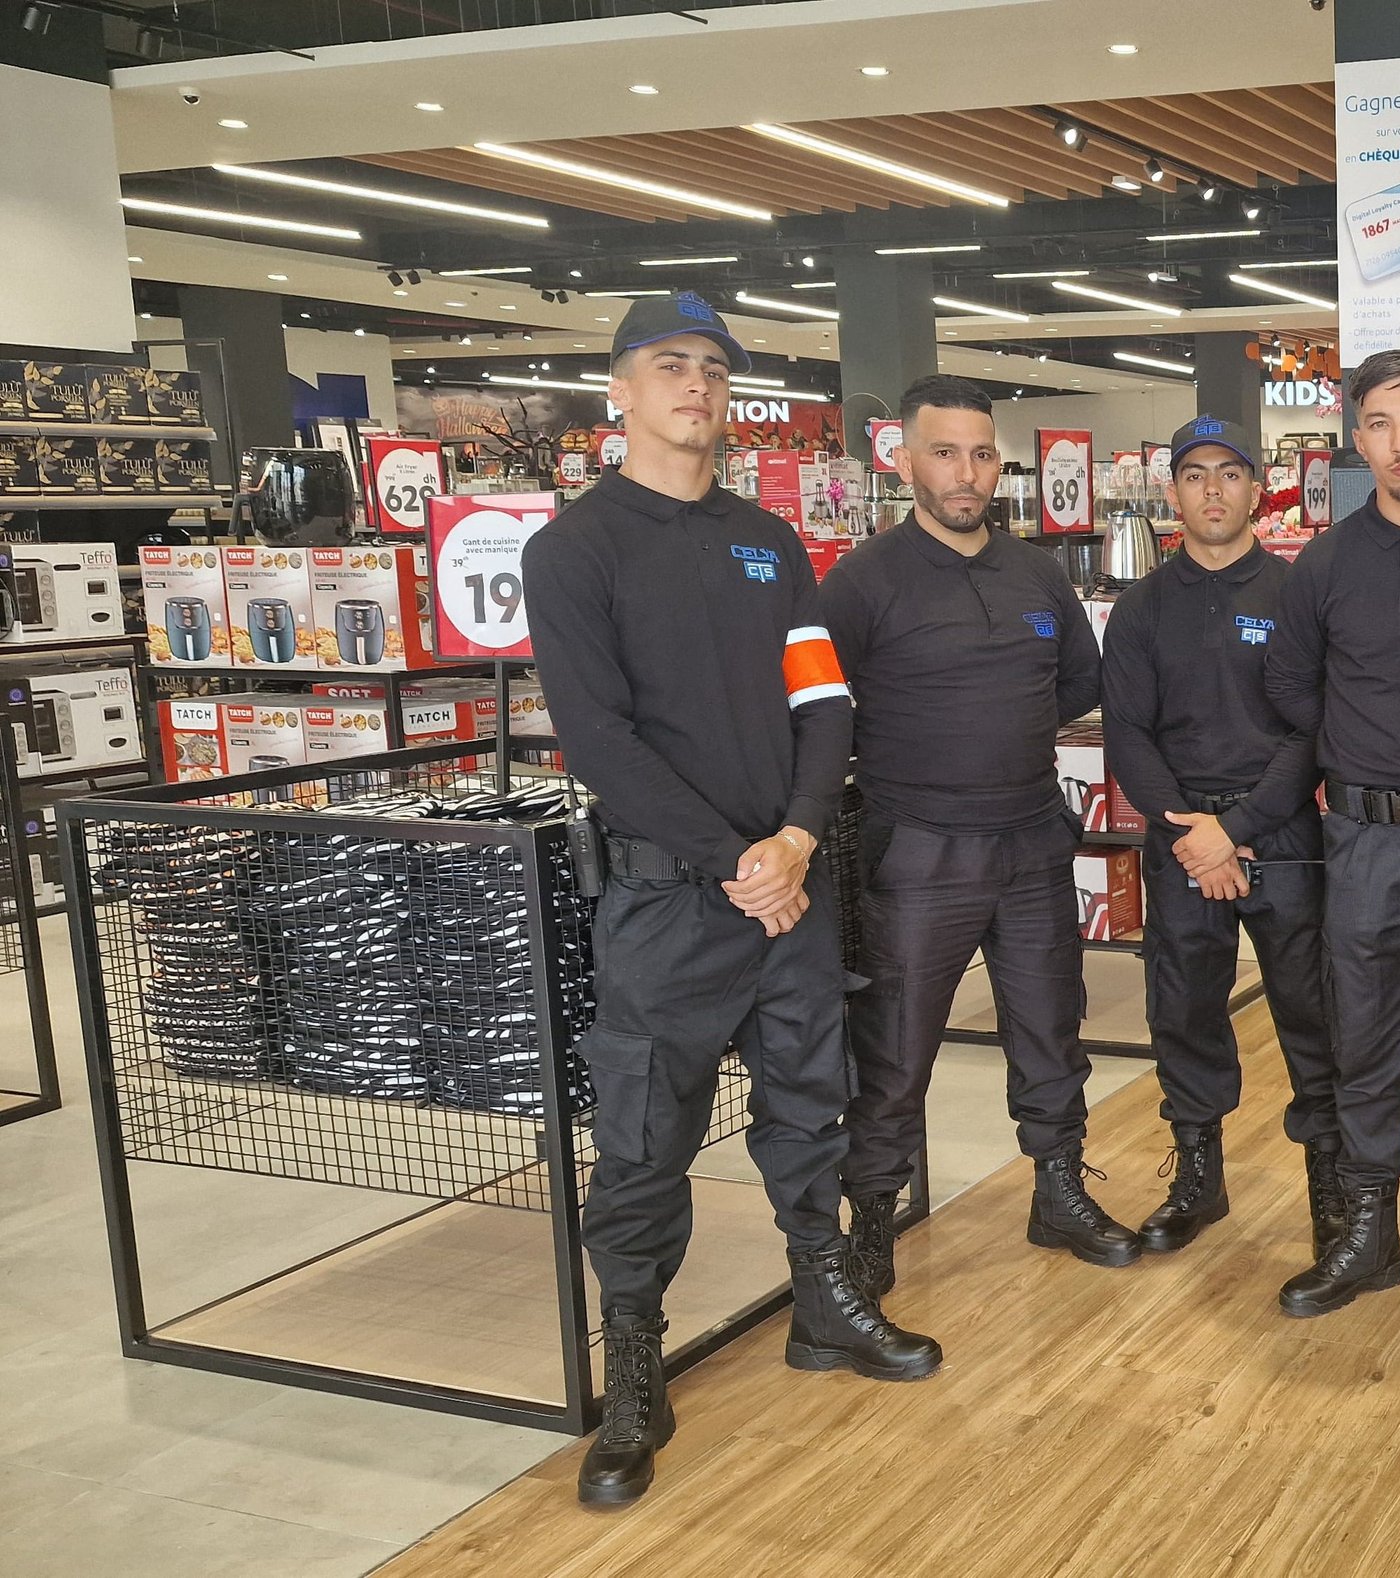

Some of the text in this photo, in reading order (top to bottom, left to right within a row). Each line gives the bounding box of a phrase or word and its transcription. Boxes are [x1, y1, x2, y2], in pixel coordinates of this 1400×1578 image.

[1376, 128, 1390, 137] sur
[1345, 154, 1357, 163] en
[1352, 210, 1372, 222] Digital
[1371, 201, 1393, 214] Loyalty
[1362, 219, 1391, 239] 1867
[1352, 297, 1385, 306] Valable
[1353, 327, 1374, 337] Offre
[1375, 328, 1394, 337] pour
[1354, 341, 1365, 350] de
[564, 467, 582, 477] 229
[1075, 466, 1086, 478] dh
[423, 473, 437, 483] dh
[1052, 478, 1079, 512] 89
[1306, 487, 1327, 510] 199
[463, 538, 520, 546] Gant de cuisine
[145, 551, 169, 559] TATCH
[485, 546, 518, 555] manique
[731, 545, 780, 563] CELYA
[80, 550, 112, 564] Teffo
[227, 552, 253, 560] TATCH
[314, 552, 340, 560] TATCH
[745, 562, 775, 582] CTS
[464, 572, 523, 623] 19
[1235, 616, 1275, 630] CELYA
[1242, 628, 1266, 644] CTS
[96, 677, 128, 691] Teffo
[476, 701, 496, 709] TATC
[176, 708, 211, 720] TATCH
[228, 708, 253, 717] TATCH
[307, 711, 332, 719] TATCH
[409, 710, 450, 725] TATCH
